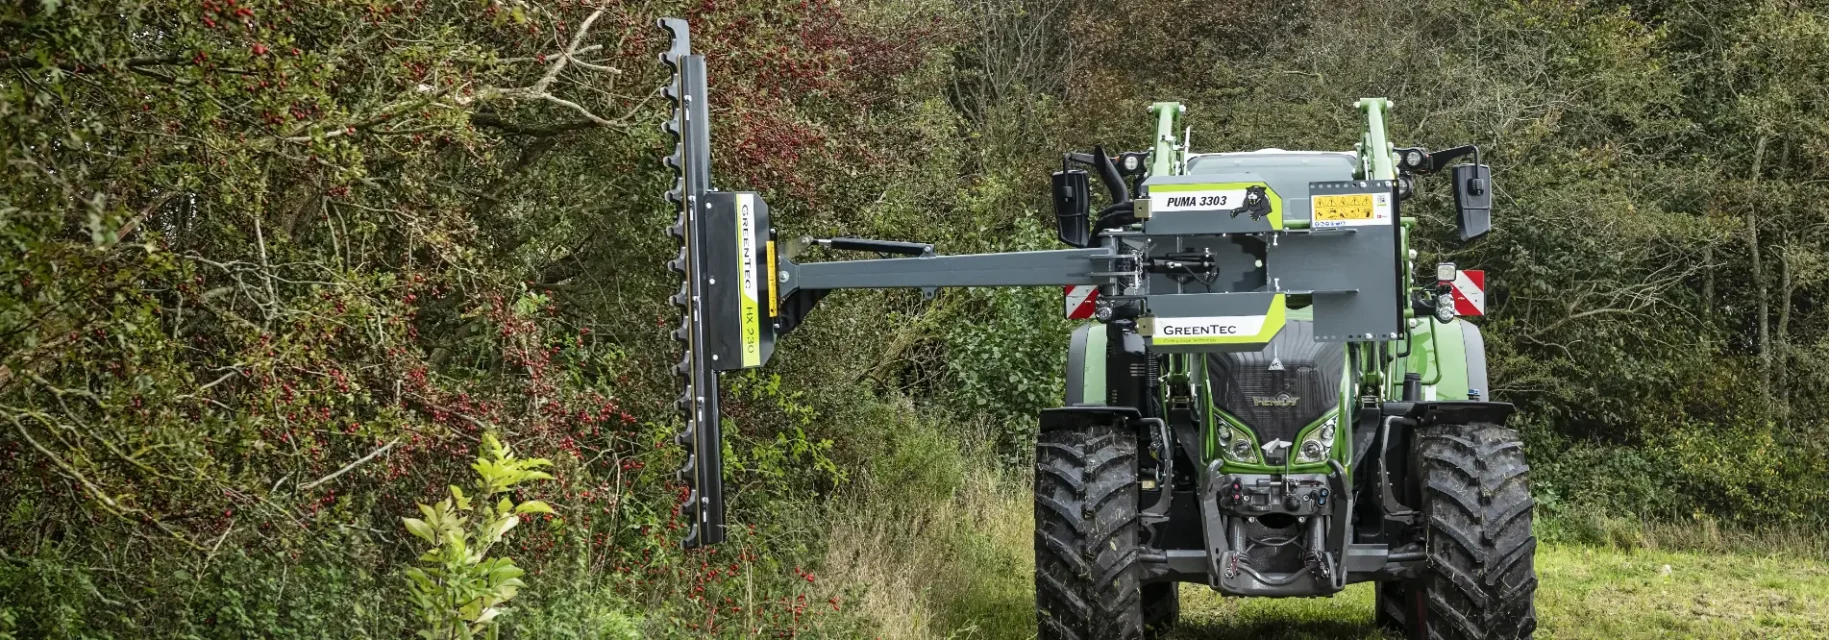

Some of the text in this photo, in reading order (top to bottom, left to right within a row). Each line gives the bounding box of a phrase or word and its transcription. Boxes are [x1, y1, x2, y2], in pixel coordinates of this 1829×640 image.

[1167, 195, 1228, 207] PUMA 3303
[746, 306, 755, 354] HX 230
